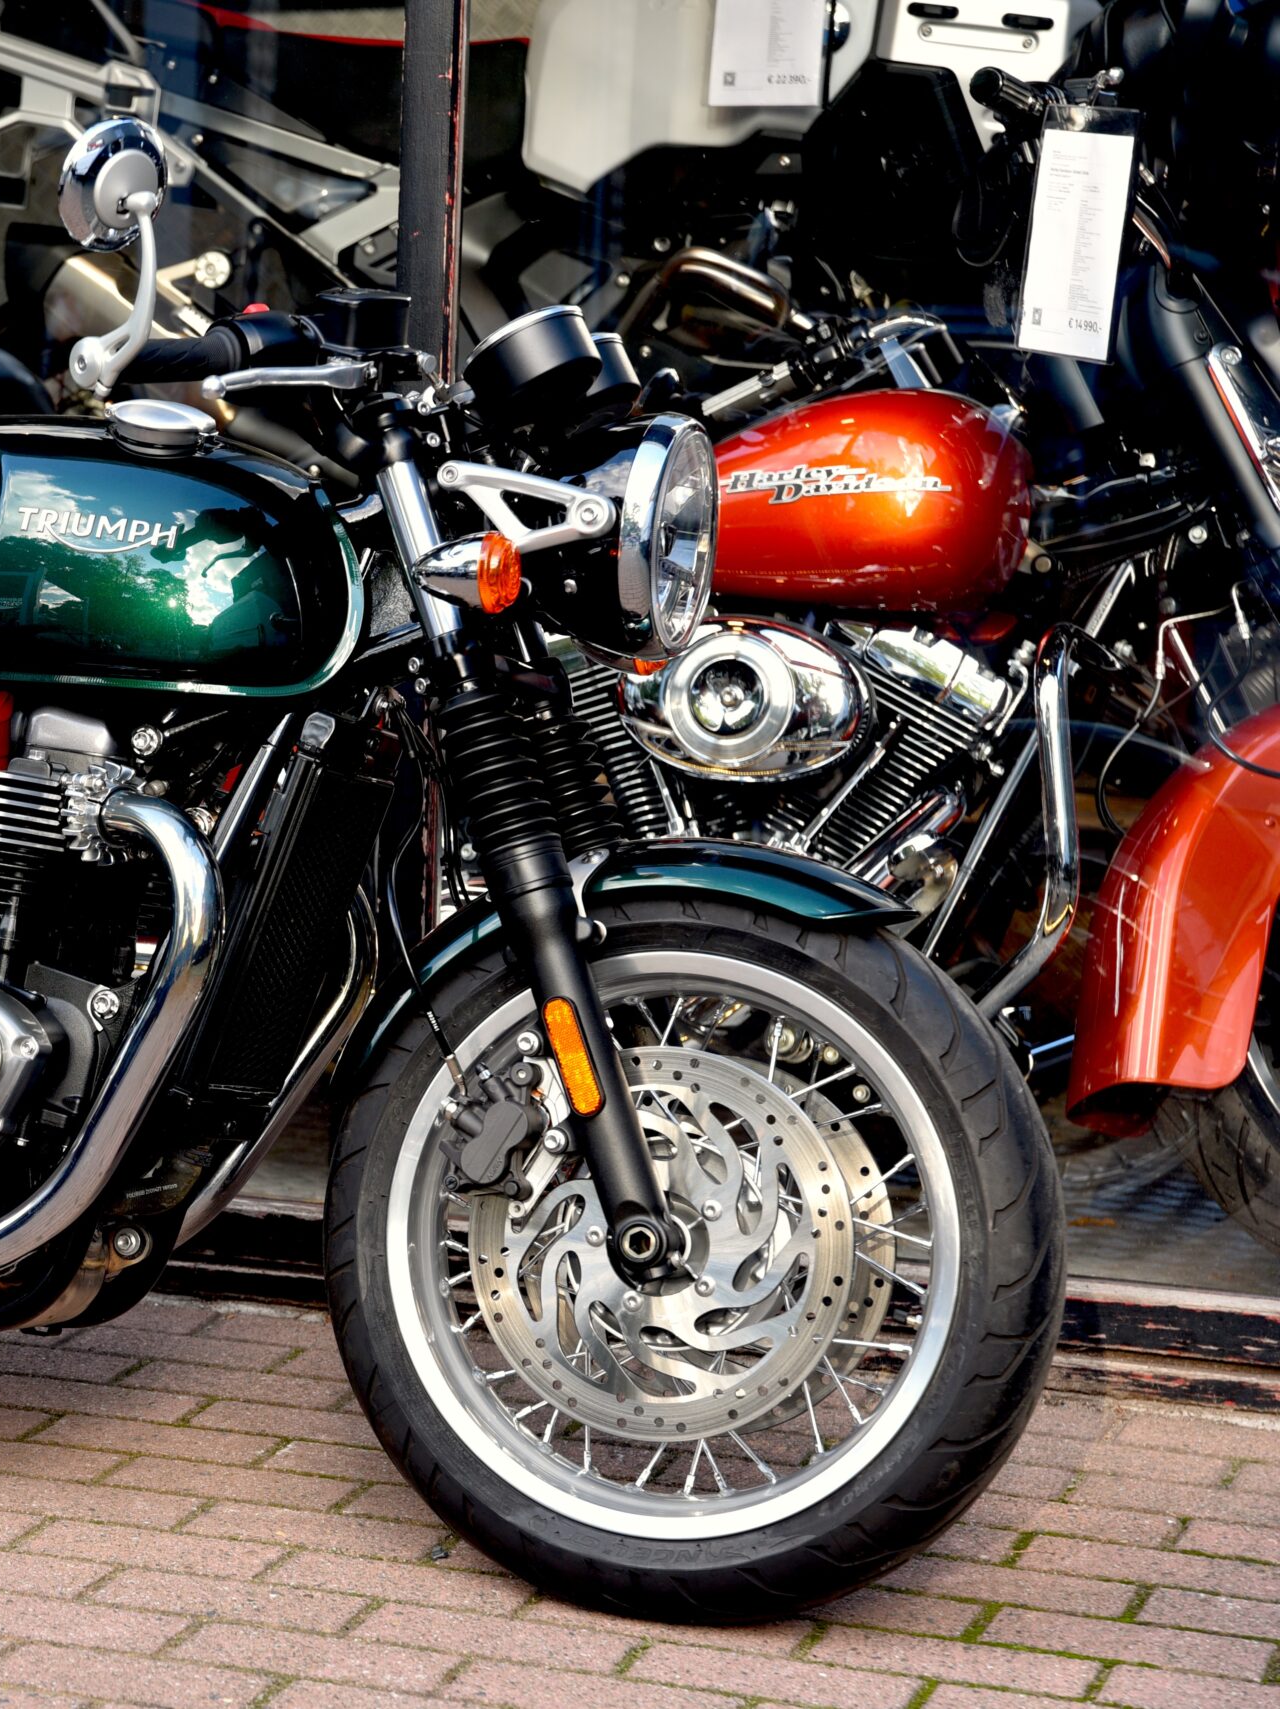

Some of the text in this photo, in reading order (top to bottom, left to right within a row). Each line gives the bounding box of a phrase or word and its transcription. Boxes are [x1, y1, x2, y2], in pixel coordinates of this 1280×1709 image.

[723, 463, 856, 495] Harley
[768, 473, 949, 505] Davidn
[19, 506, 178, 554] TRIUMPH
